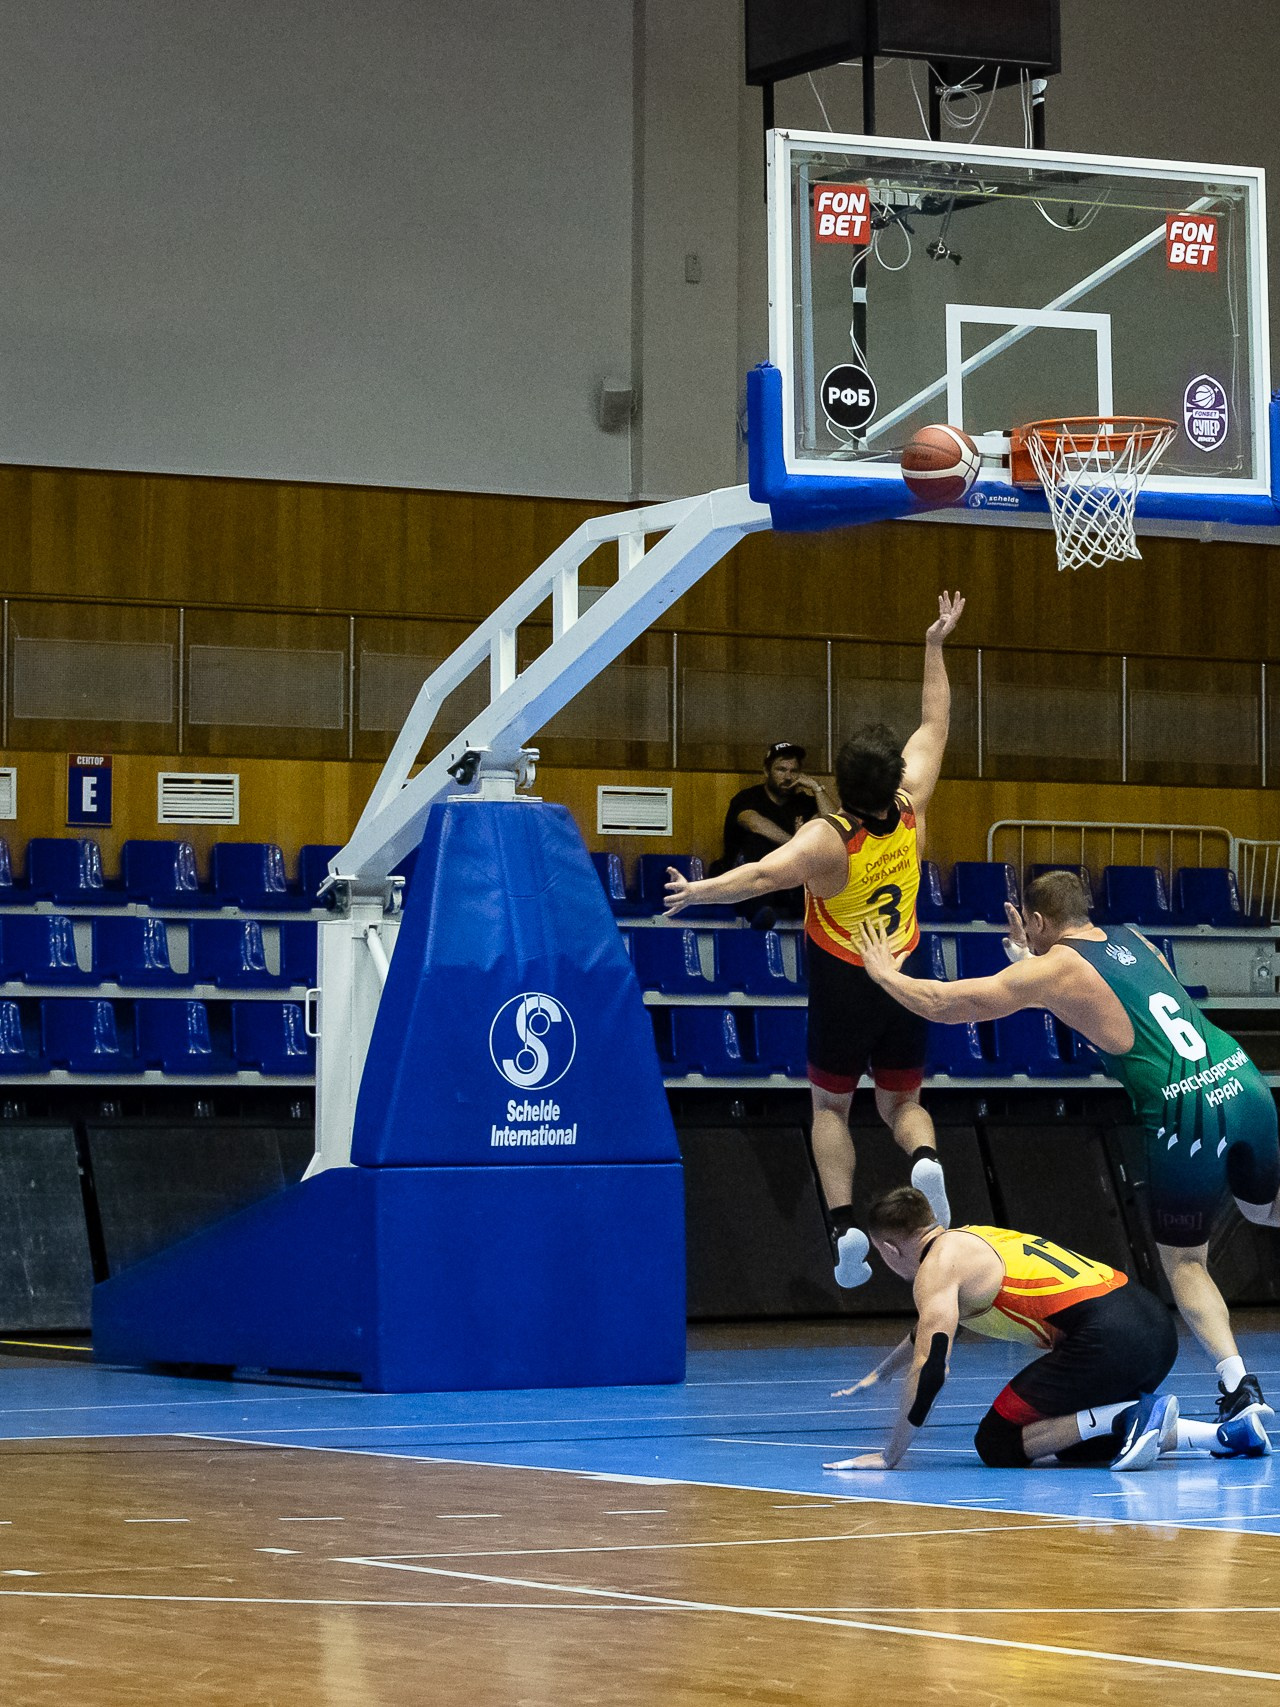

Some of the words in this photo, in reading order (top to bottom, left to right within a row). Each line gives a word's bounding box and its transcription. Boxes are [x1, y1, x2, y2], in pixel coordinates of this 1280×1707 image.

[817, 191, 866, 214] FON
[818, 213, 867, 237] BET
[1169, 221, 1215, 244] FON
[1169, 242, 1215, 266] BET
[828, 386, 871, 407] РФБ
[1192, 418, 1221, 437] СУПЕР
[864, 883, 903, 937] 3
[1148, 991, 1207, 1062] 6
[1161, 1046, 1249, 1101] КРАСНОЯРСКИЙ
[1204, 1076, 1245, 1108] КРАЙ
[506, 1099, 561, 1123] Schelde
[490, 1123, 578, 1147] International
